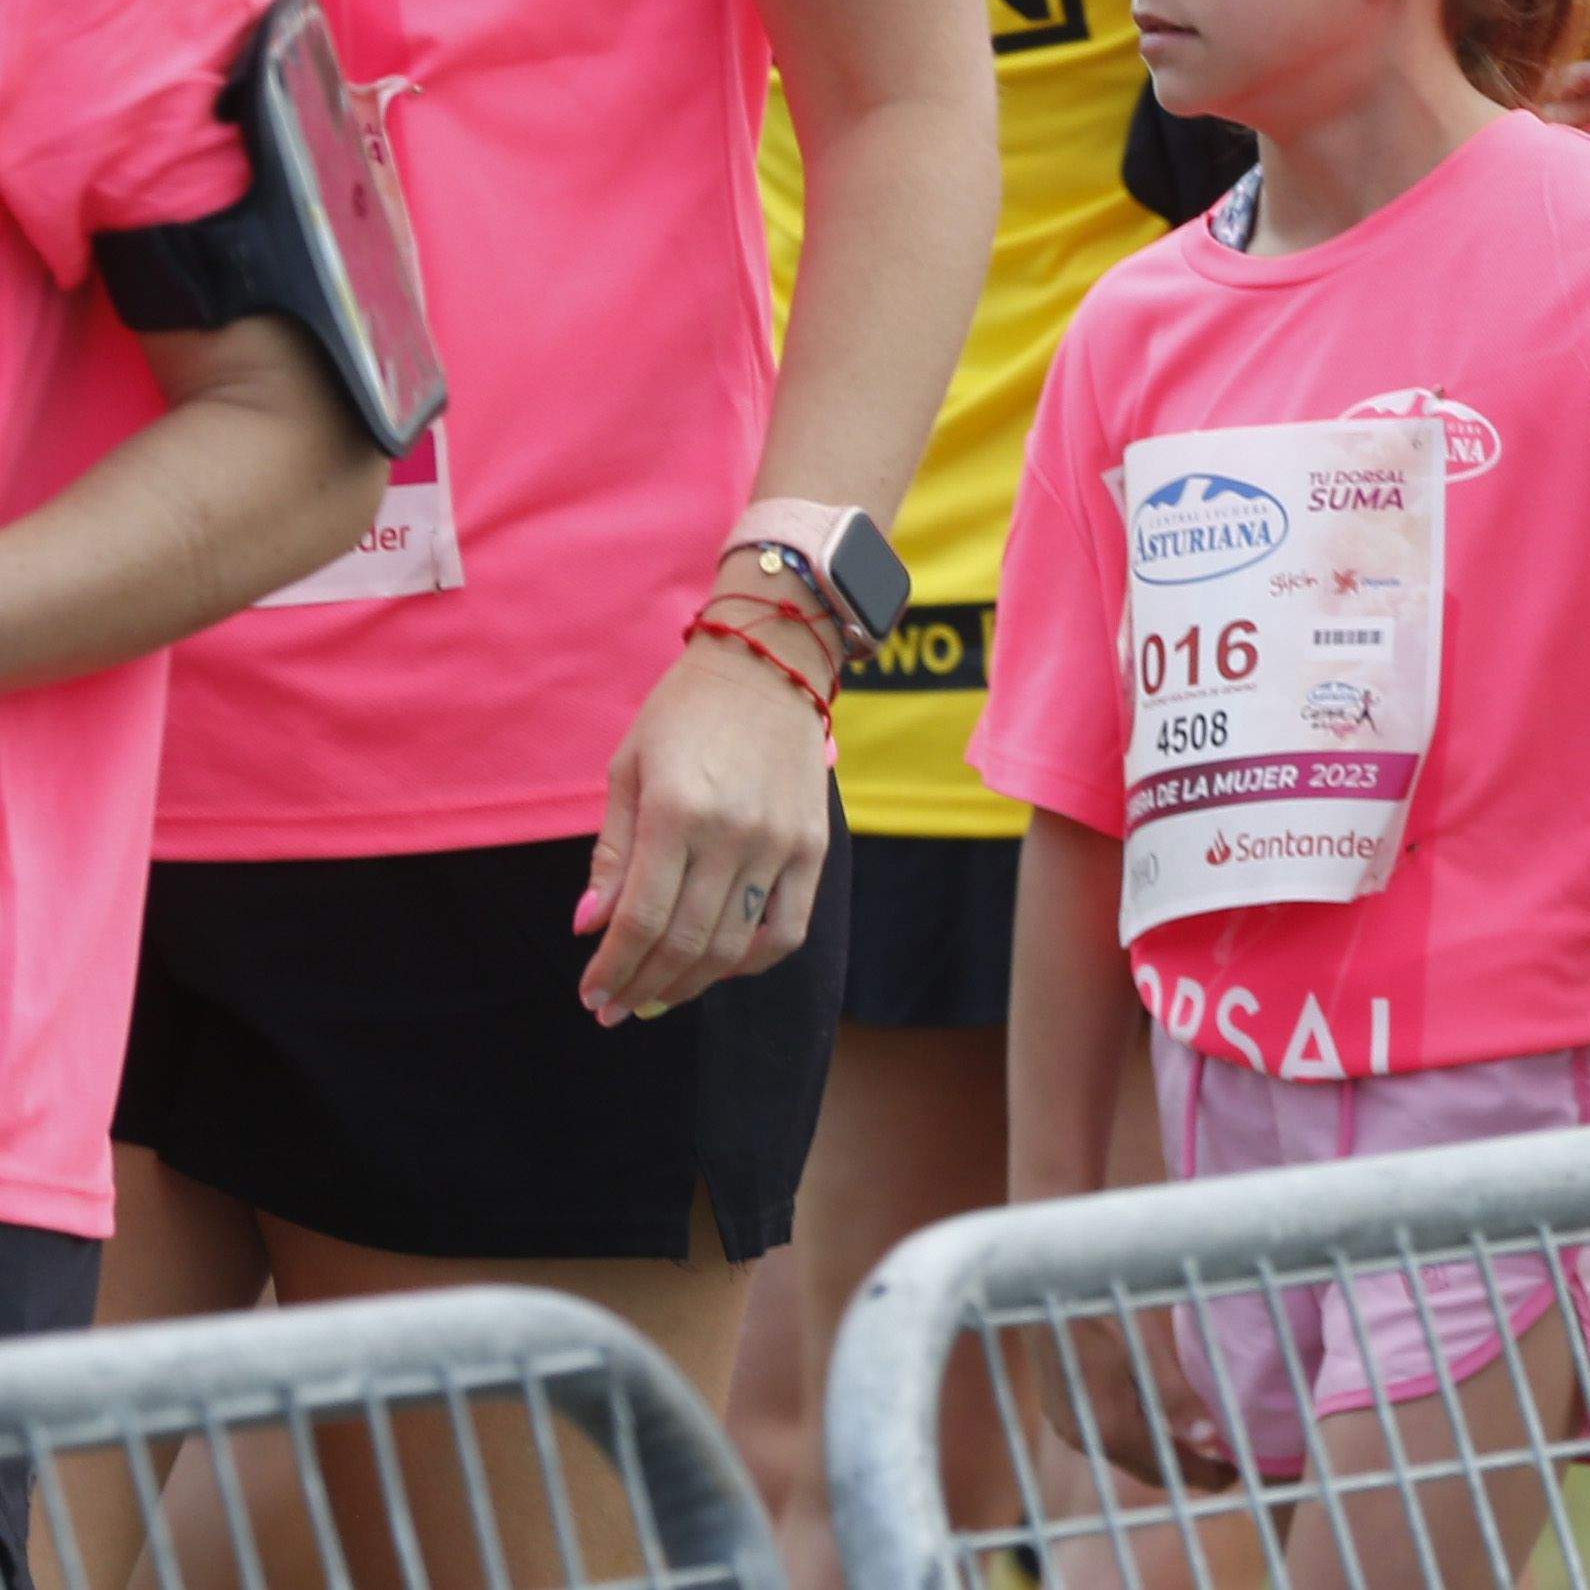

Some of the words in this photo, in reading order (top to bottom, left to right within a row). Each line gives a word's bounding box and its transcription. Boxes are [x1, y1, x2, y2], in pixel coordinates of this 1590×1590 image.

[1307, 486, 1406, 512] SUMA
[1136, 517, 1275, 563] ASTURIANA
[1141, 619, 1259, 696] 016
[1156, 710, 1228, 756] 4508
[1182, 774, 1210, 802] LA
[1212, 763, 1299, 796] MUJER
[1308, 762, 1380, 789] 2023
[1233, 828, 1386, 861] Santander
